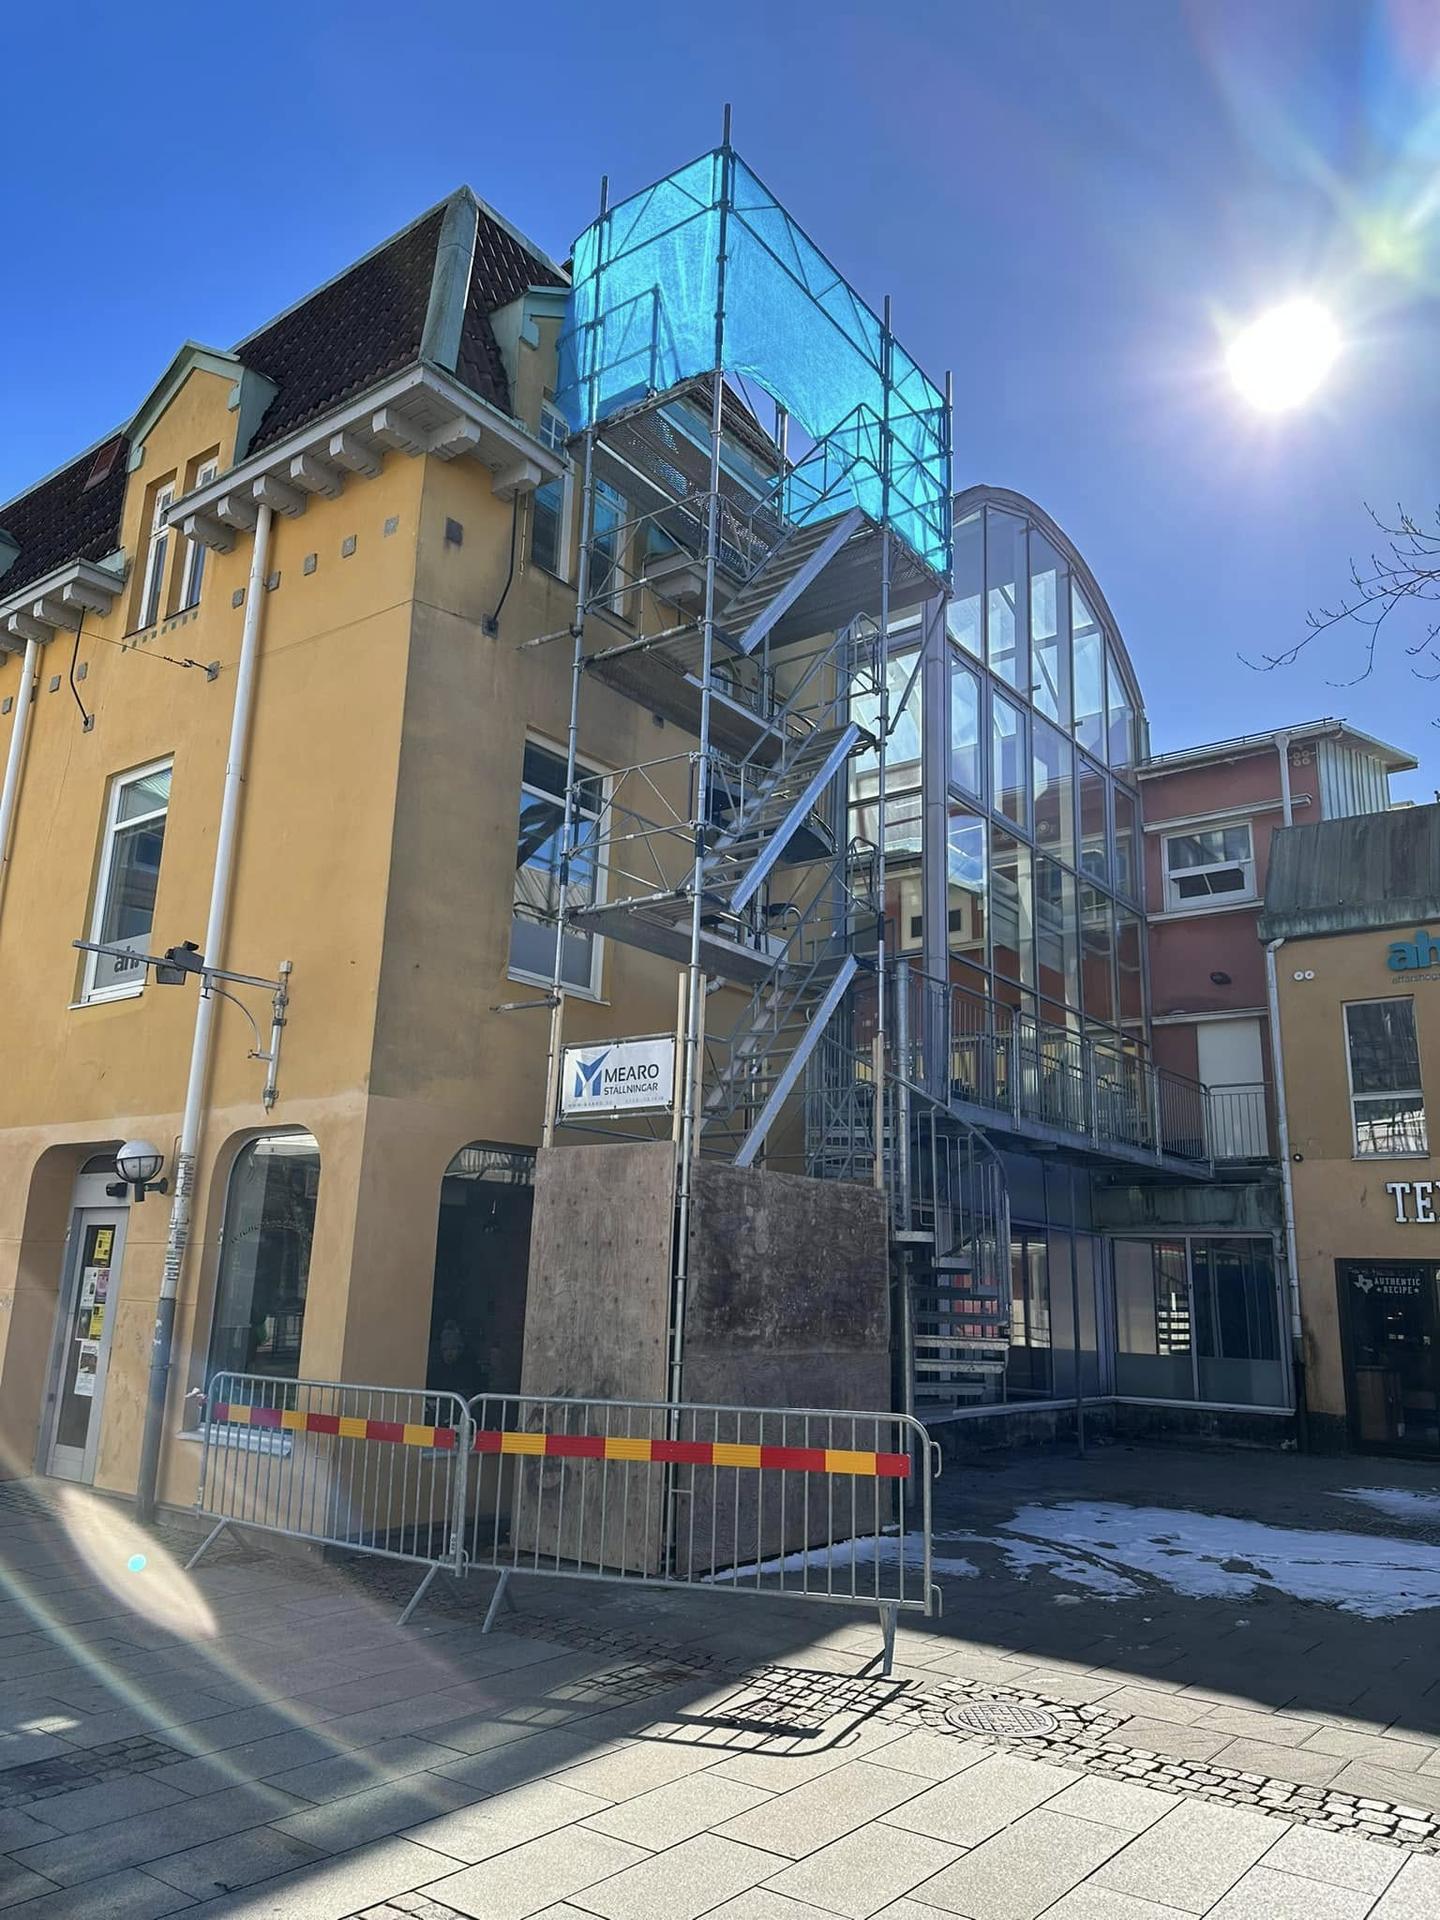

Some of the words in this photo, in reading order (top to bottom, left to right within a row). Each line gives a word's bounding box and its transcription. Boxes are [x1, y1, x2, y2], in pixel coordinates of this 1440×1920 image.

[604, 1064, 659, 1083] MEARO
[1386, 1182, 1440, 1223] TE
[1374, 1277, 1421, 1286] AUTHENTIC
[1383, 1286, 1412, 1294] RECIPE
